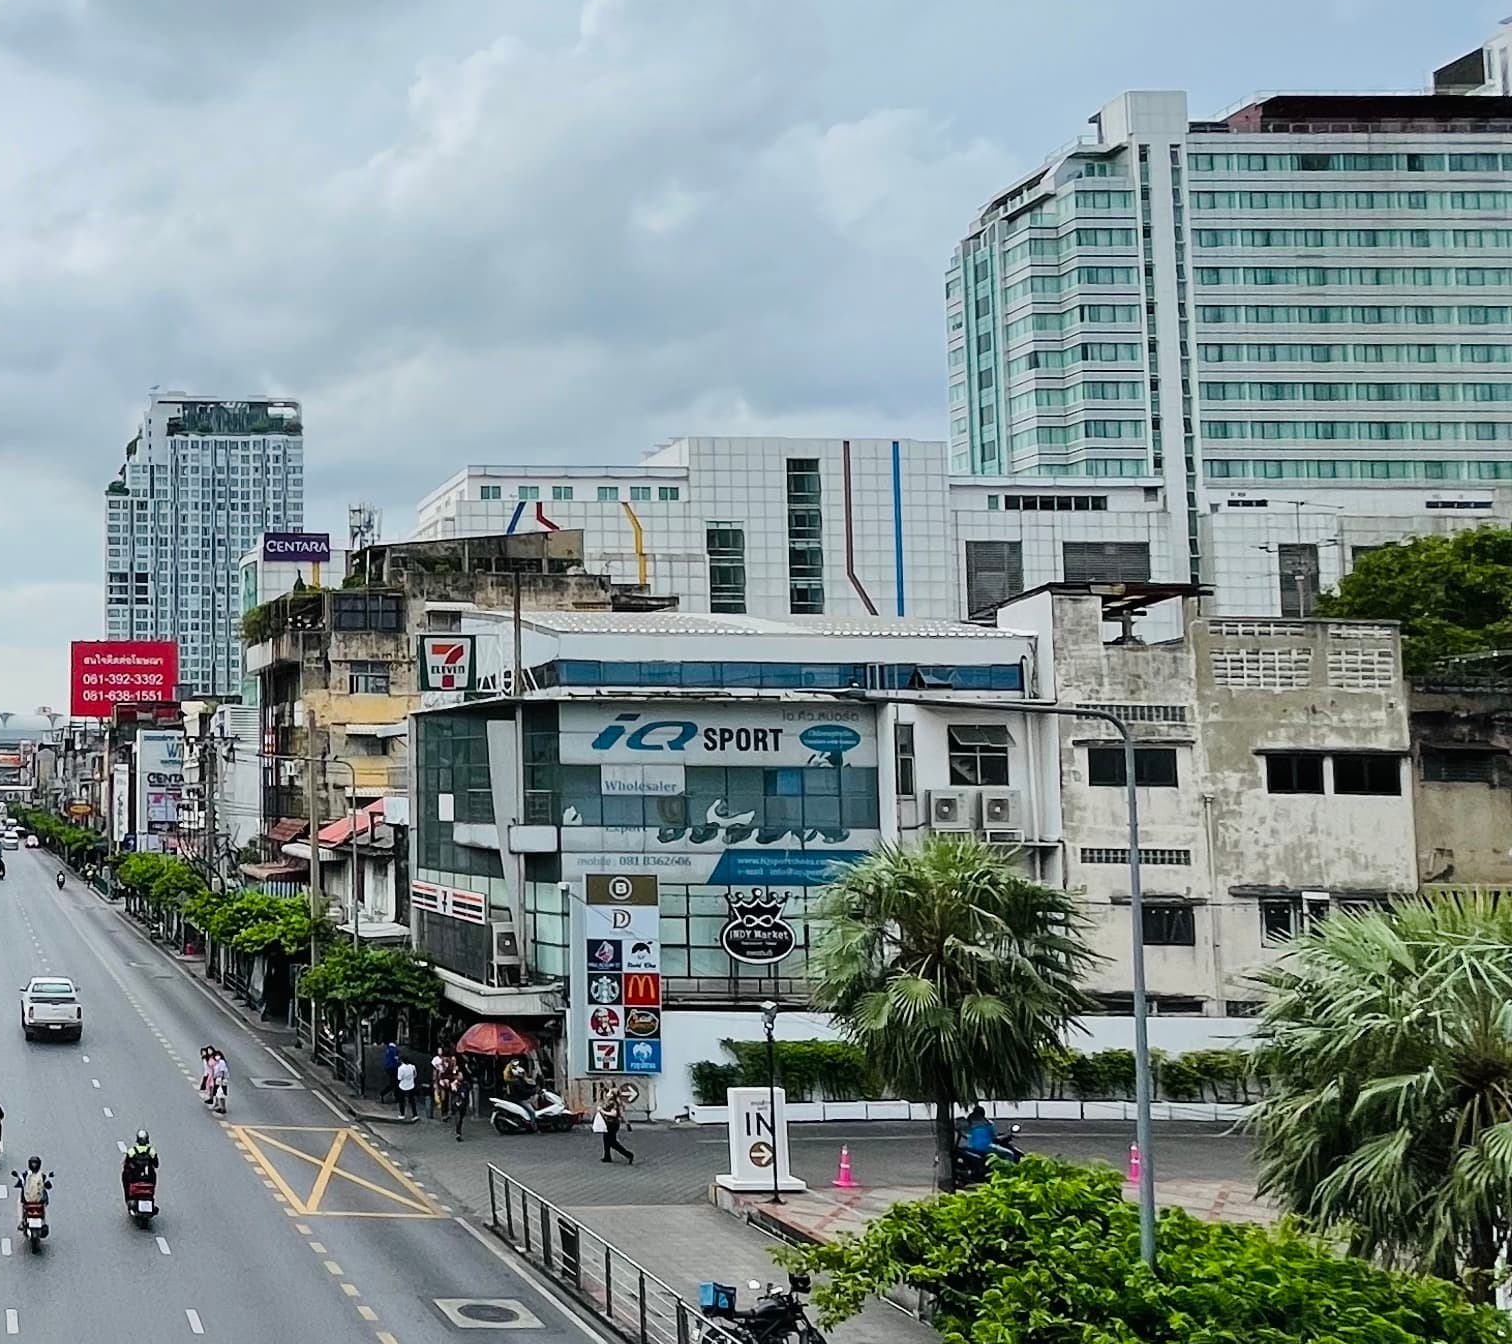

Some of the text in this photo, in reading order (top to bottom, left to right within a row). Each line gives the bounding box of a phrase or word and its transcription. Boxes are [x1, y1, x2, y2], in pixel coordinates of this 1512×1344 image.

[266, 540, 329, 553] CENTARA
[703, 727, 784, 752] SPORT
[604, 779, 678, 794] Wholesaler
[729, 929, 789, 940] INDY Market
[745, 1112, 774, 1137] IN
